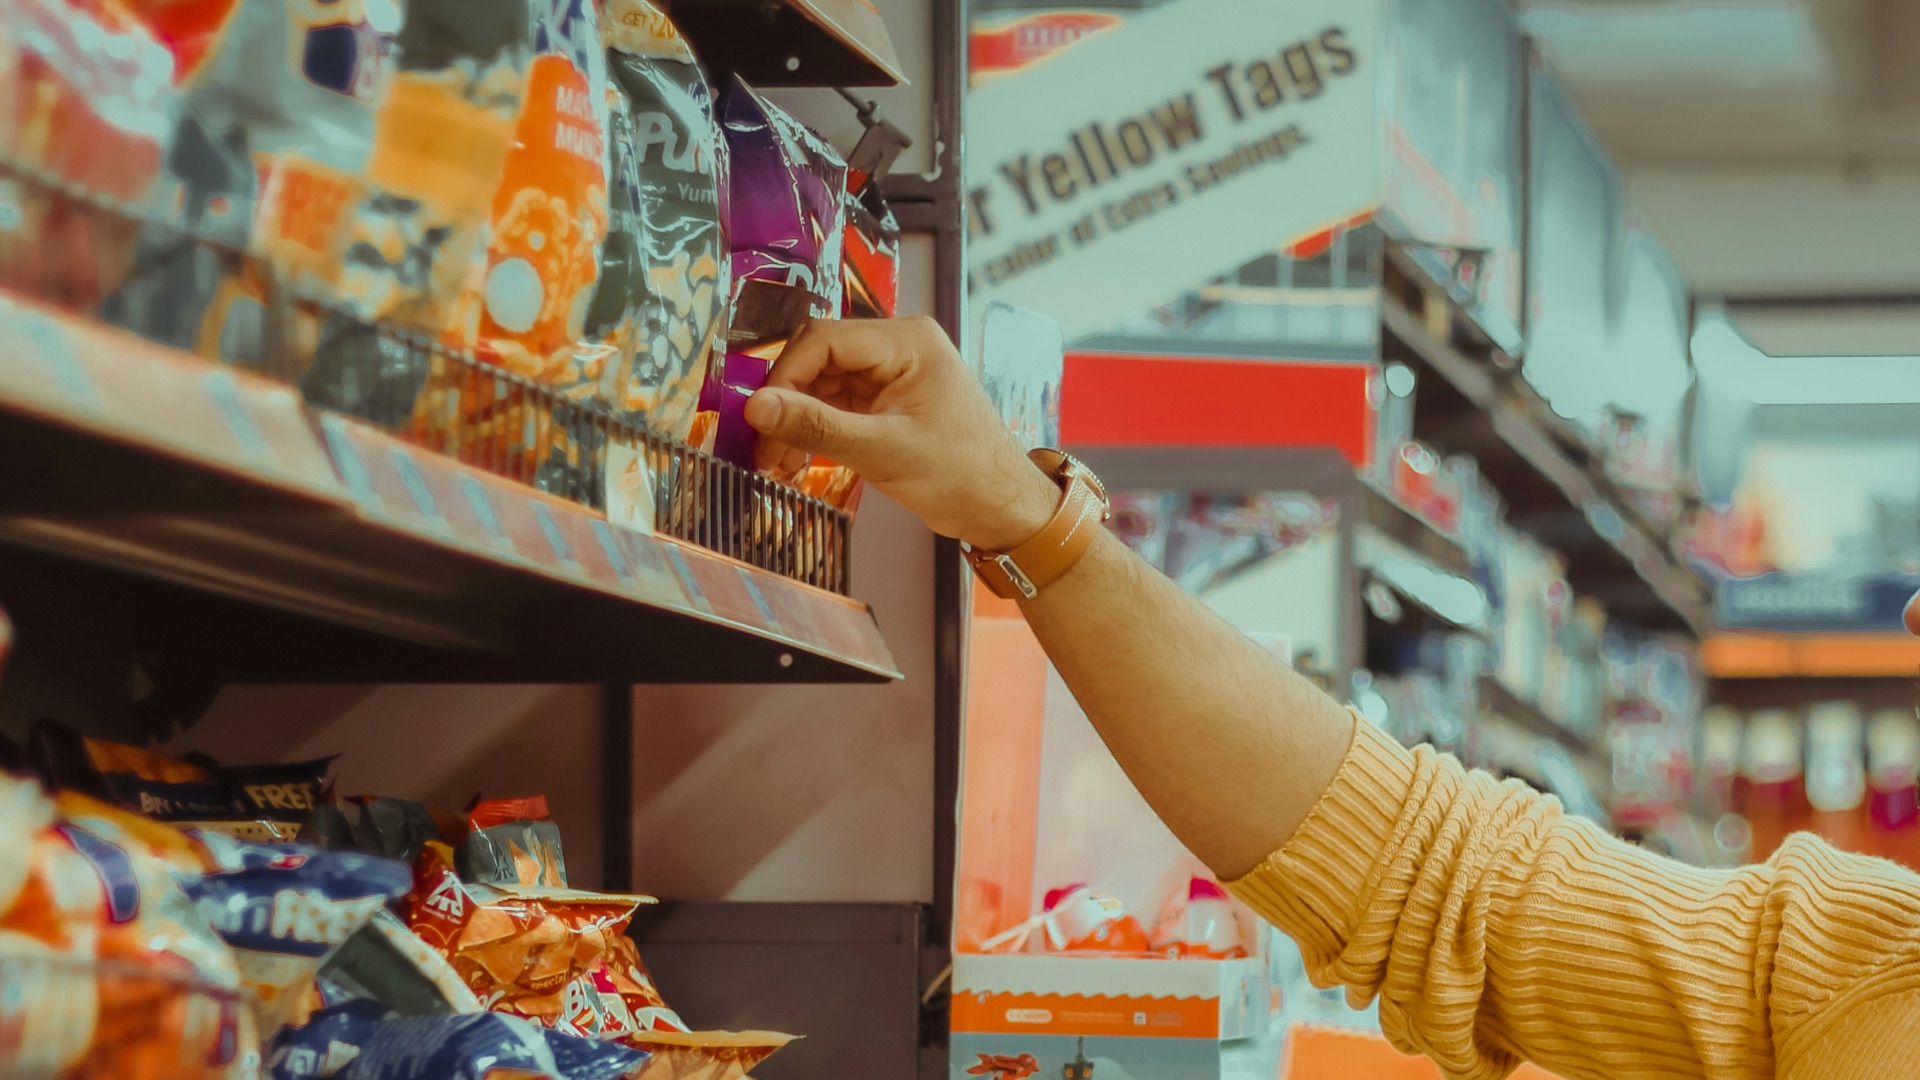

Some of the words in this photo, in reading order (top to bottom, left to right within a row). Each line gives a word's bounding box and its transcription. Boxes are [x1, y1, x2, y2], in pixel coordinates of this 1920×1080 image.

[622, 12, 647, 28] GET
[966, 183, 992, 240] r
[1000, 91, 1204, 216] Yellow
[1207, 25, 1356, 123] Tags
